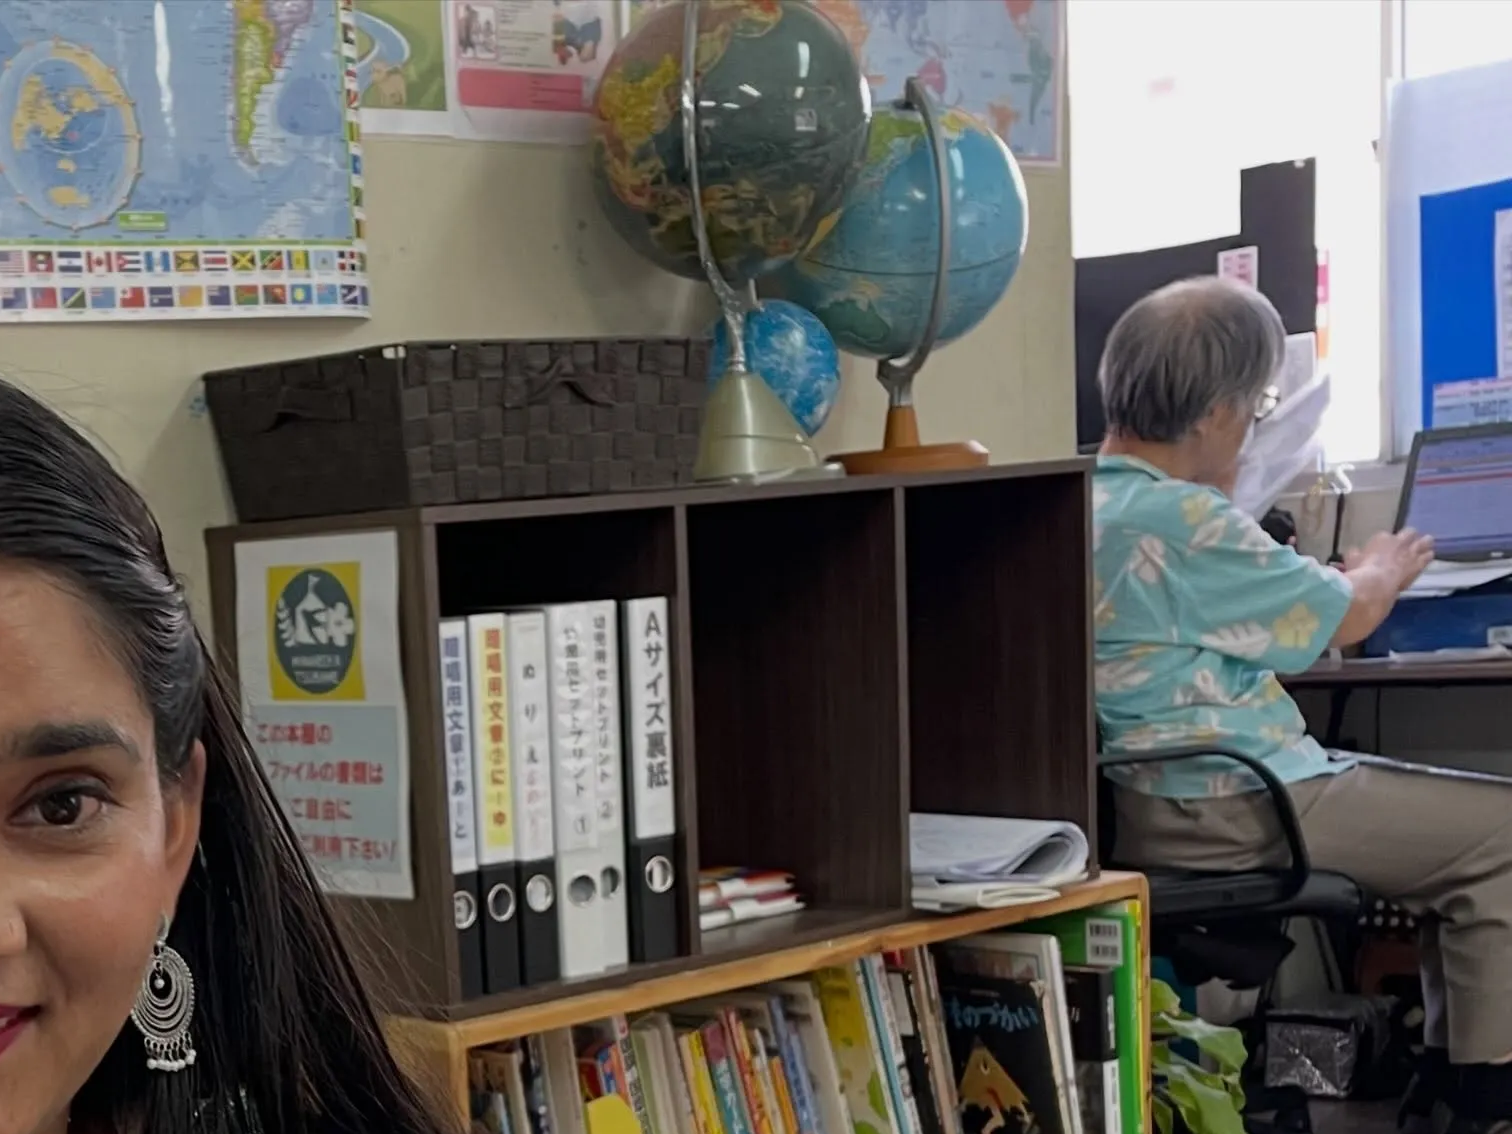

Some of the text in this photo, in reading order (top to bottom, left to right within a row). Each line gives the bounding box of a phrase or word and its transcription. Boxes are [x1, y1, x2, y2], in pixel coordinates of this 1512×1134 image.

[644, 610, 669, 790] Aサイズ裏紙
